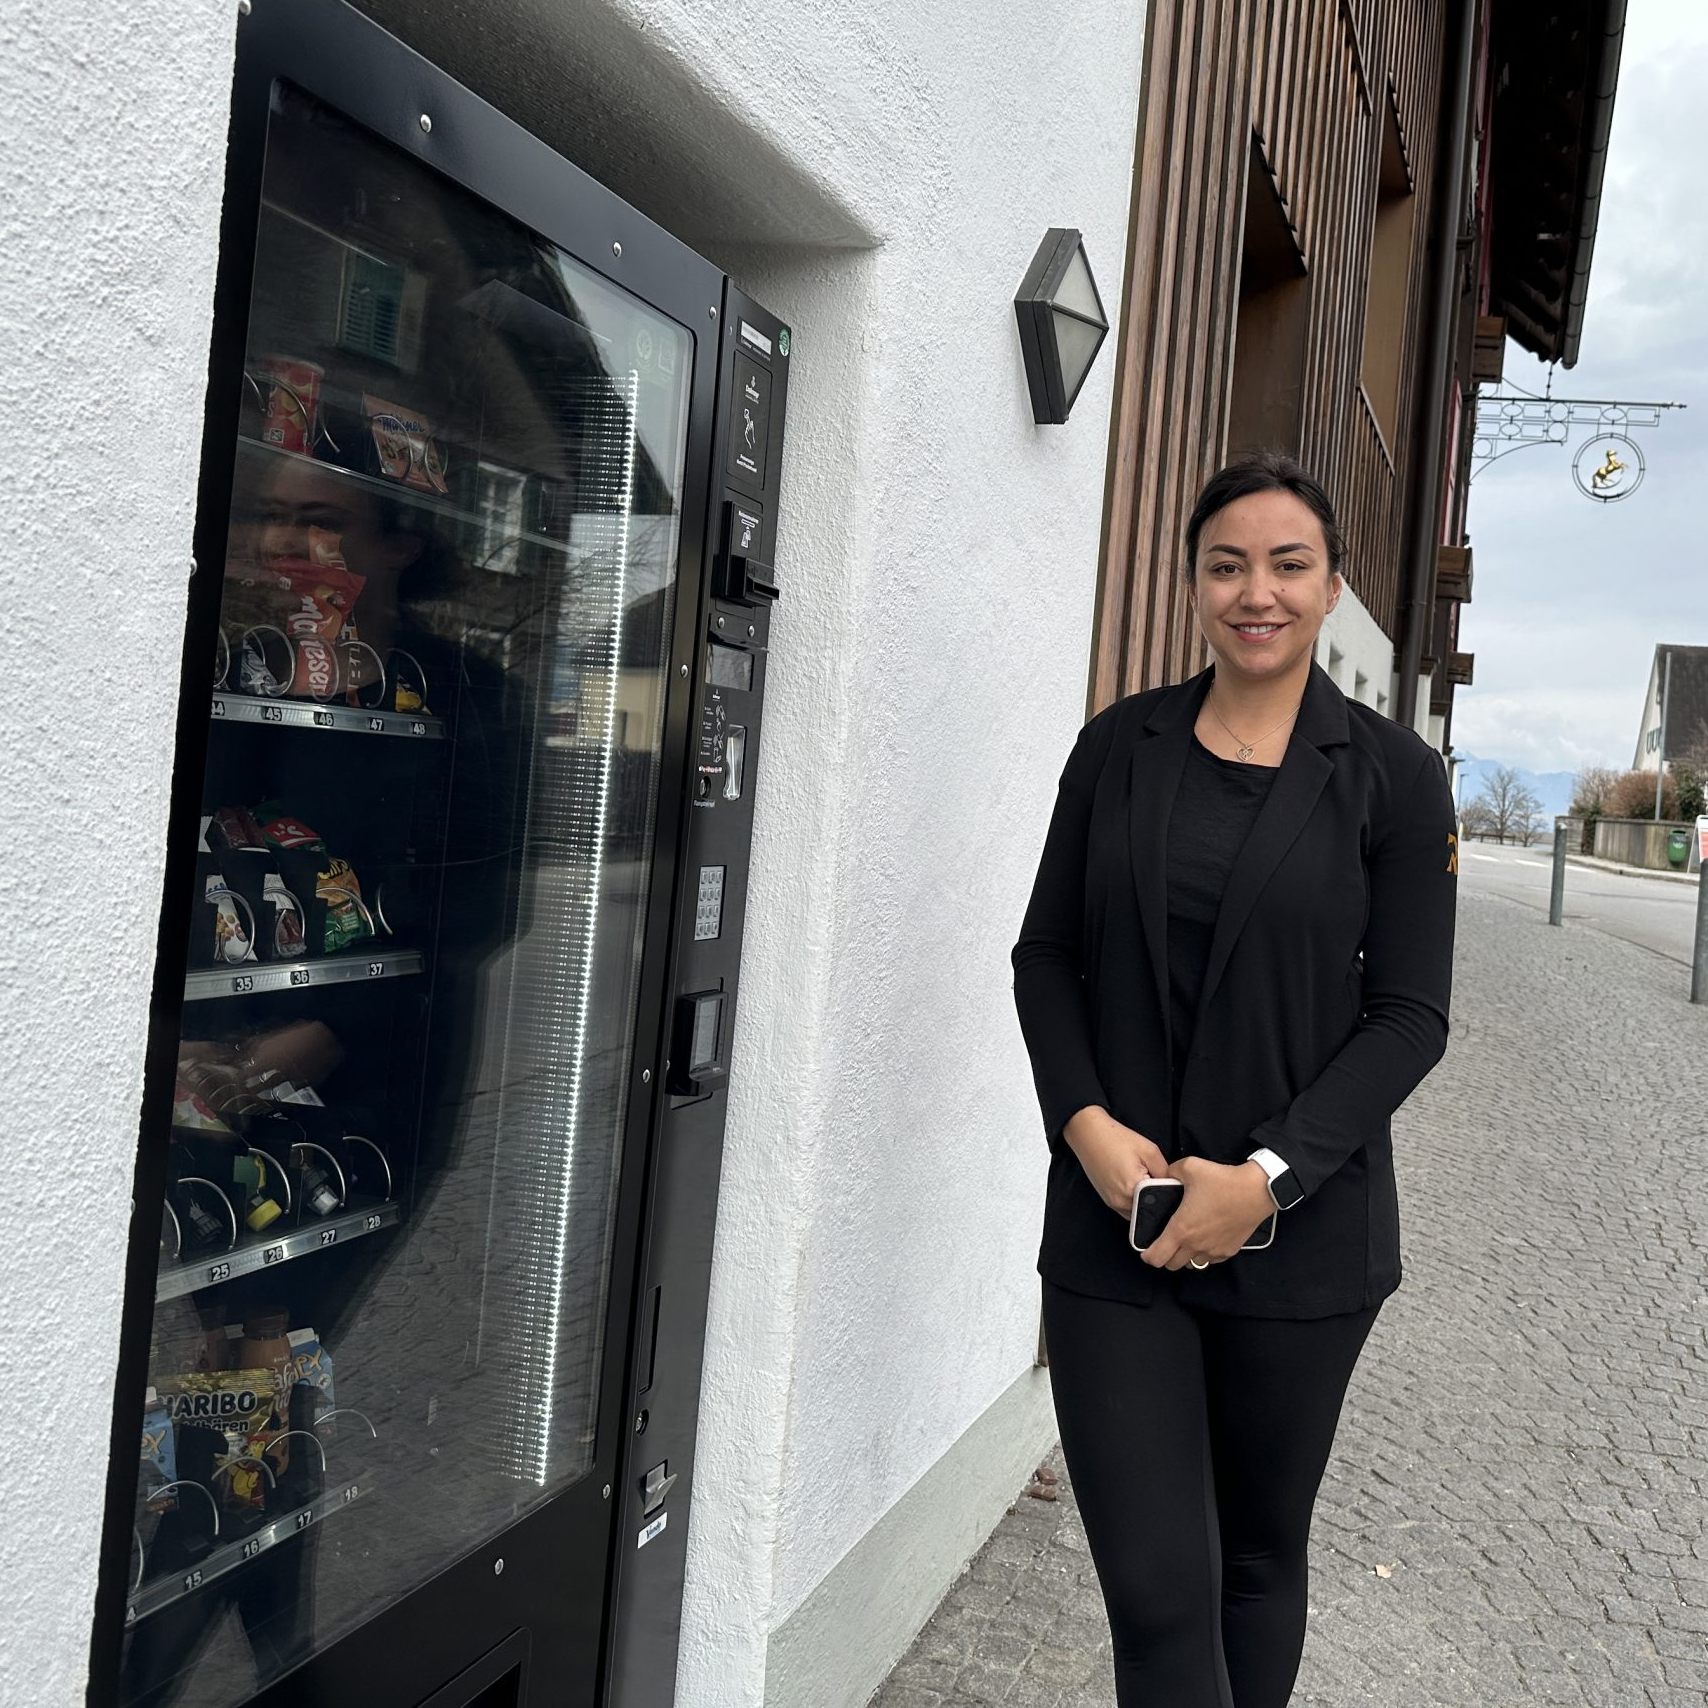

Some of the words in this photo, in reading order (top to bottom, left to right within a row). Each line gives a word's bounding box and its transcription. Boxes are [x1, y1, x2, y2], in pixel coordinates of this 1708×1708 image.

[211, 701, 224, 715] 44
[265, 707, 281, 721] 45
[318, 713, 333, 727] 46
[370, 718, 383, 731] 47
[413, 723, 425, 735] 48
[236, 977, 252, 991] 35
[293, 971, 308, 984] 36
[370, 963, 383, 976] 37
[211, 1265, 229, 1281] 25
[267, 1248, 283, 1262] 26
[321, 1230, 336, 1244] 27
[367, 1216, 381, 1229] 28
[185, 1571, 202, 1588] 15
[244, 1541, 259, 1557] 16
[298, 1512, 312, 1526] 17
[345, 1486, 358, 1501] 18
